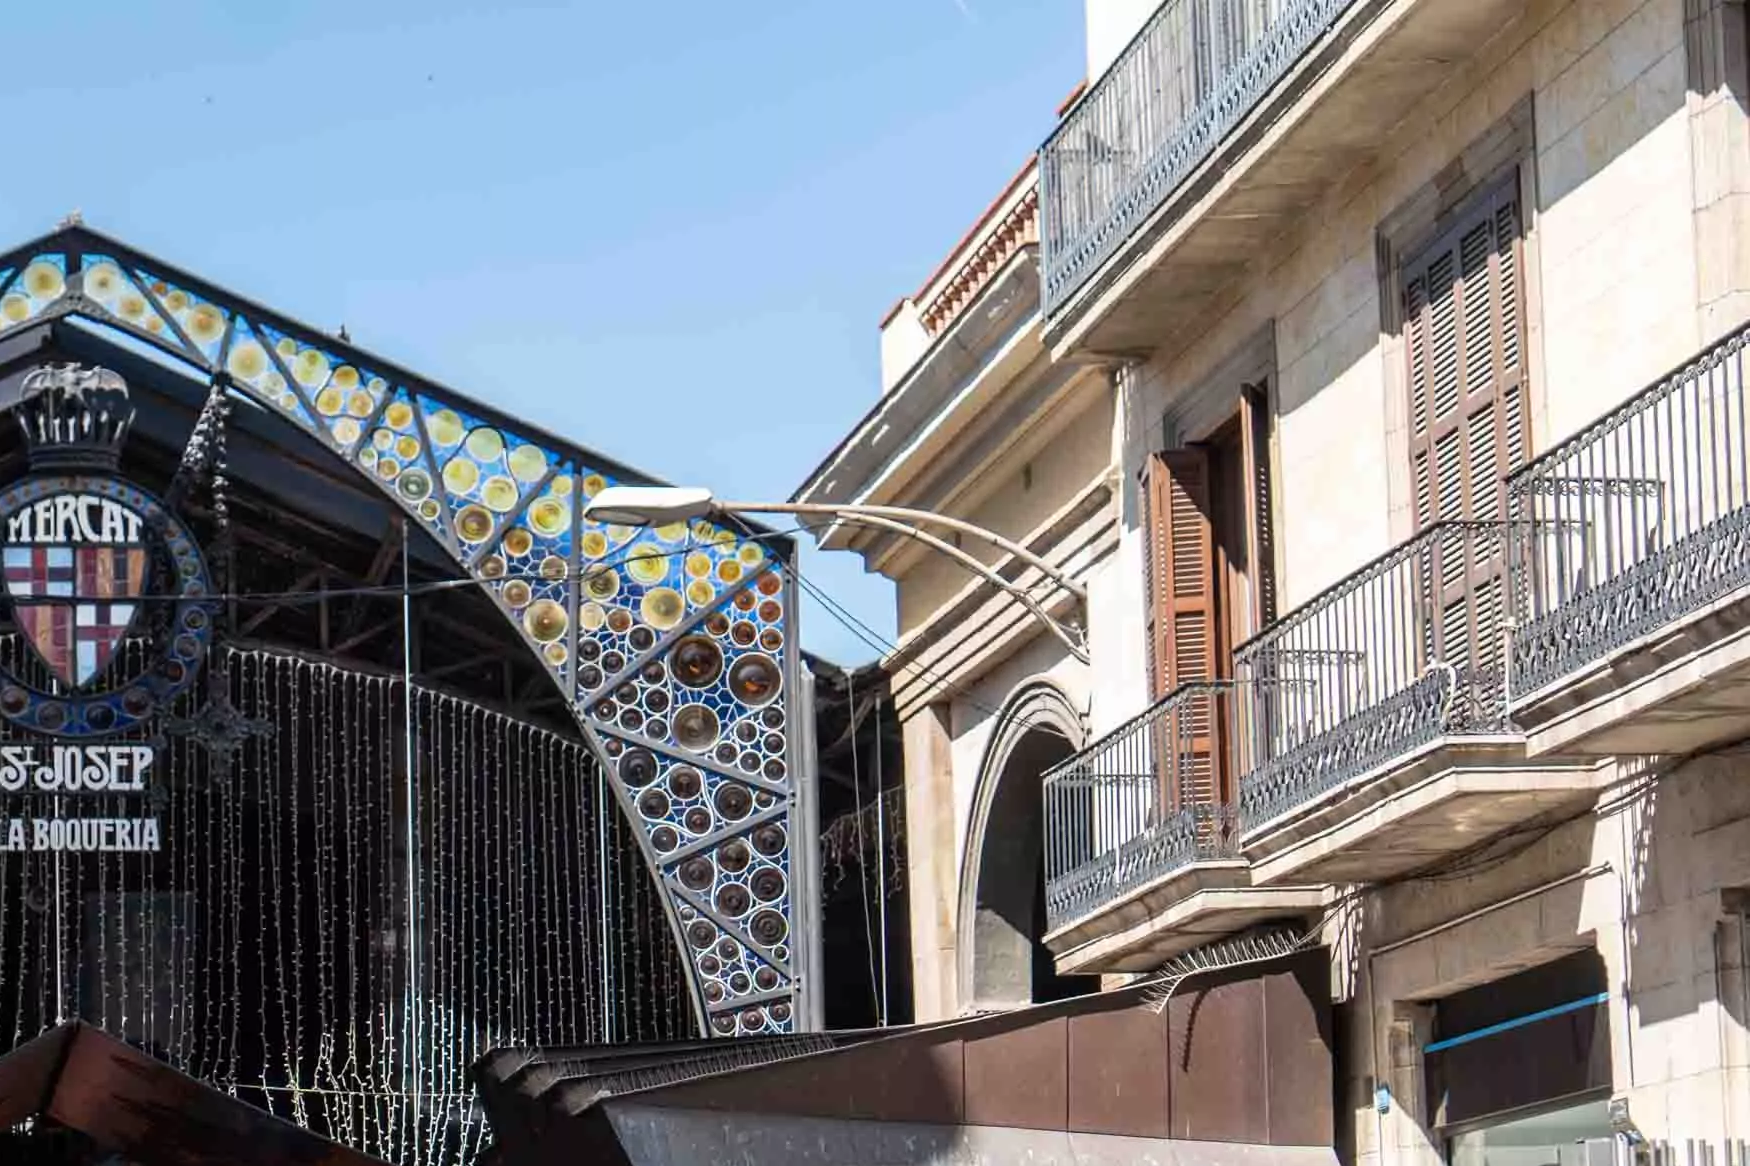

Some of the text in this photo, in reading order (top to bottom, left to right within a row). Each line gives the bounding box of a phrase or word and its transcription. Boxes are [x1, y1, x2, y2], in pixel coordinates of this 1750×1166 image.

[8, 494, 143, 543] MERCAT
[34, 745, 154, 791] JOSEP
[32, 818, 161, 851] BOQUERIA
